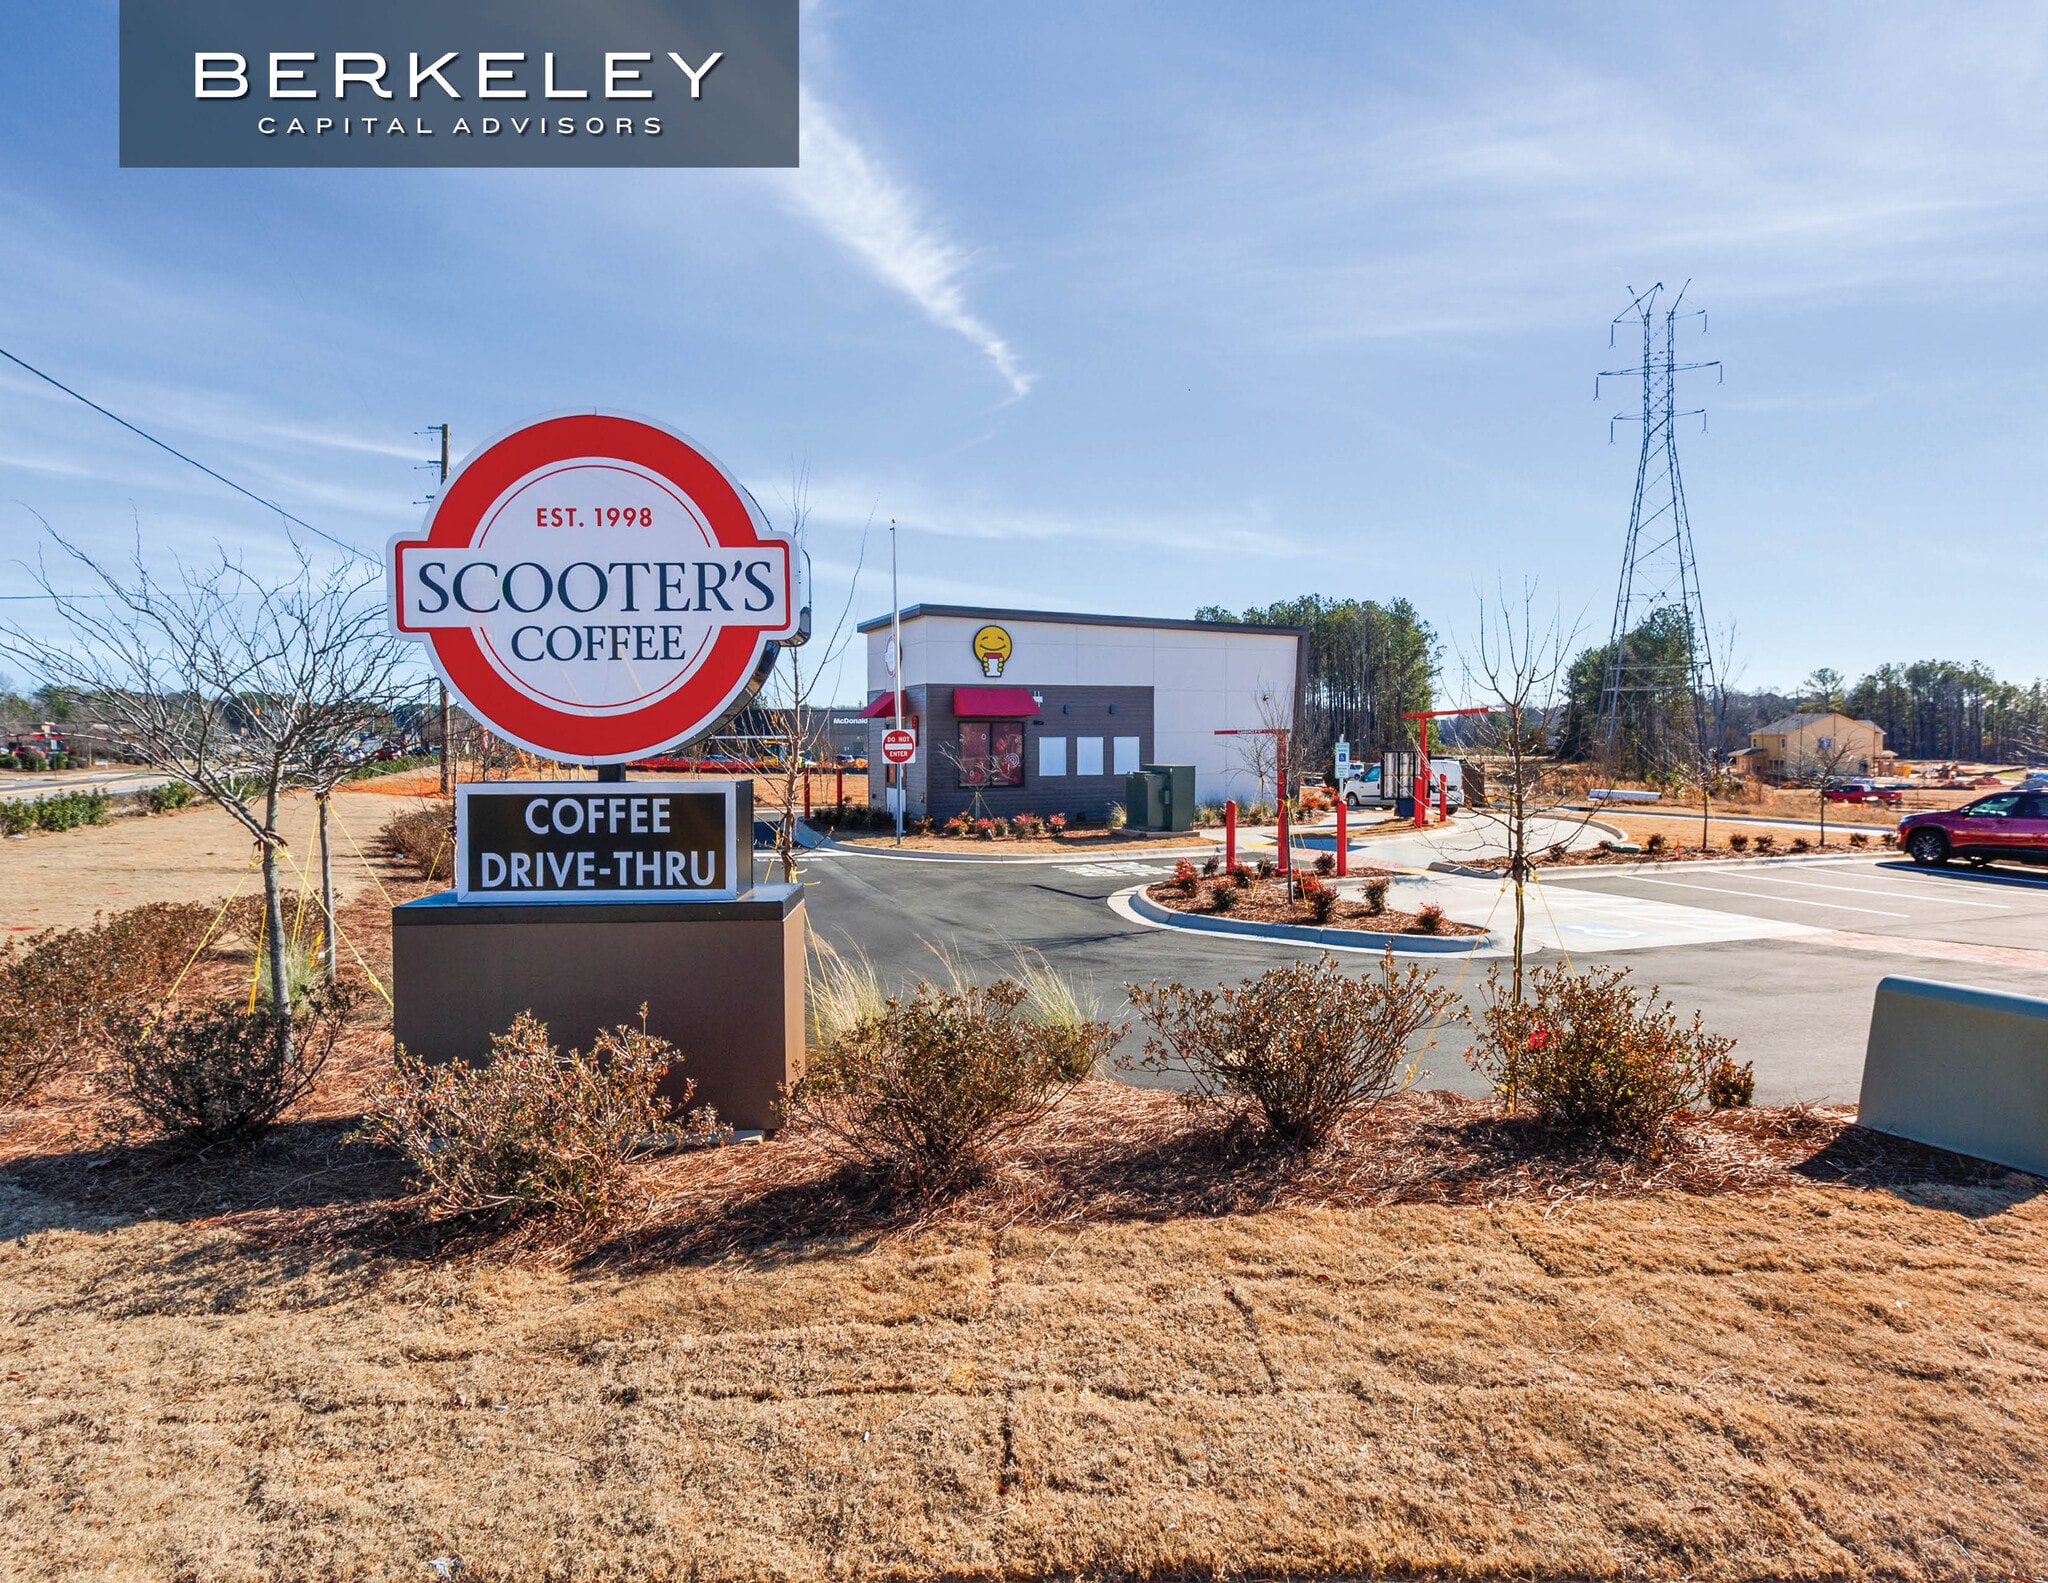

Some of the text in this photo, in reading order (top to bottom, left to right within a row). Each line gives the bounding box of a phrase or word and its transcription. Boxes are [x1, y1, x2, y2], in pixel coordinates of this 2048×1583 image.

[536, 508, 653, 528] EST. 1998
[418, 560, 775, 613] SCOOTER'S
[511, 625, 686, 661] COFFEE
[525, 798, 671, 835] COFFEE
[481, 850, 715, 888] DRIVE-THRU
